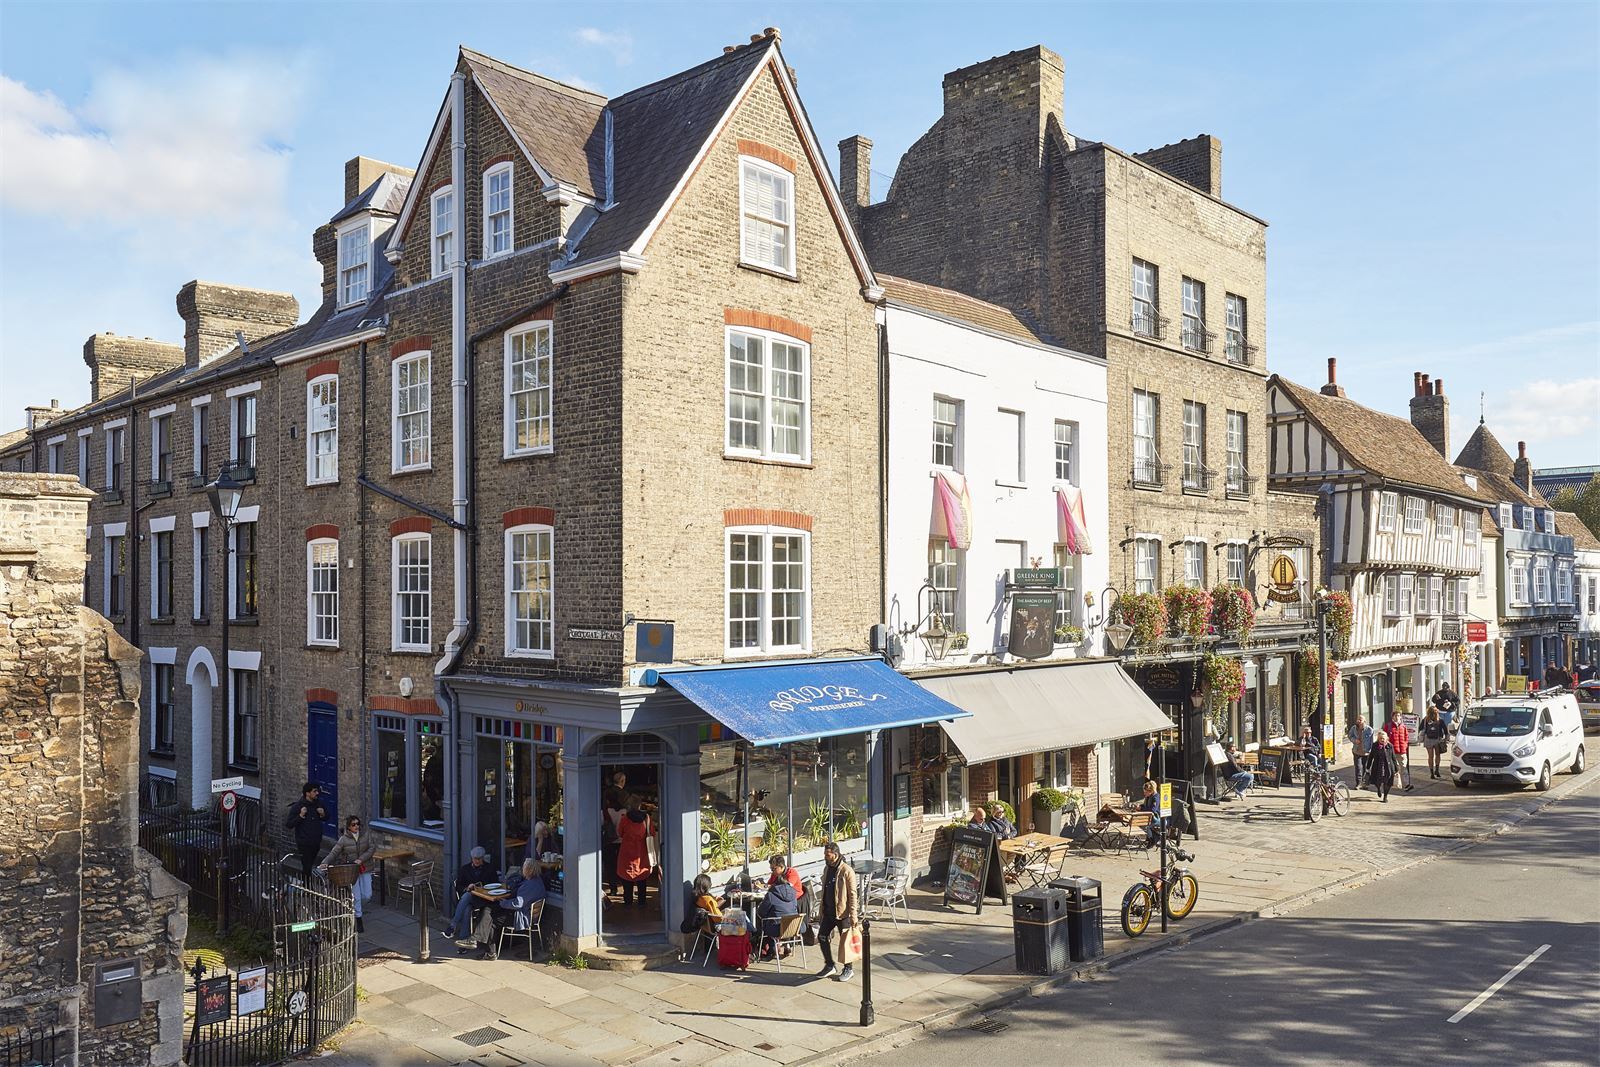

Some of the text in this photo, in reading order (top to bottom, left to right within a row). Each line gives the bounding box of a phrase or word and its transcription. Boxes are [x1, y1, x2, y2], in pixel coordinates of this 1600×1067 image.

[769, 685, 887, 712] BRIDGES
[808, 701, 866, 711] PATISSERIE
[291, 997, 305, 1010] SV
